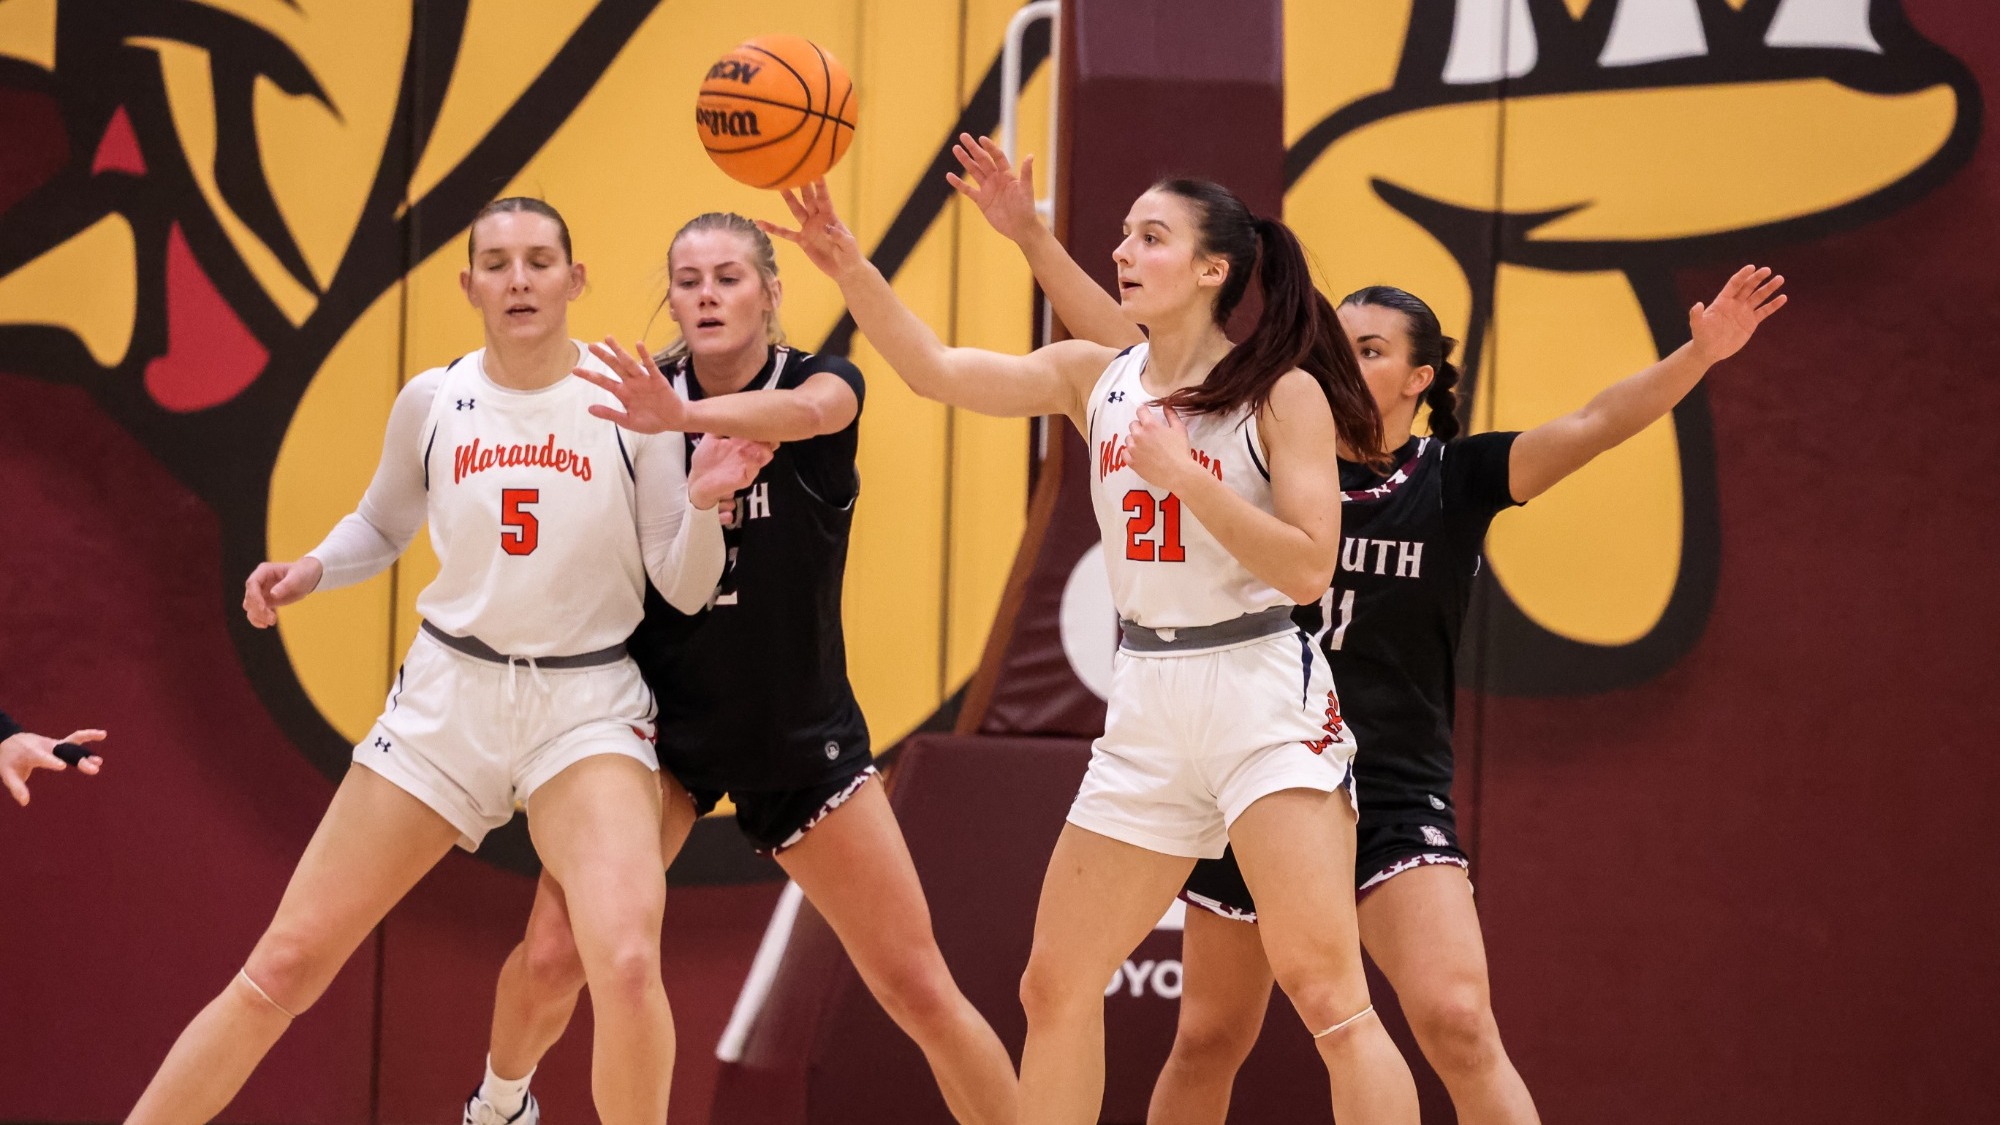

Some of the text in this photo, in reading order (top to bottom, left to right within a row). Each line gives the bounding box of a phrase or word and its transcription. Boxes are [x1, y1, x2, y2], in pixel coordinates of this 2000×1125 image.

[696, 109, 762, 137] Wilso
[454, 433, 592, 485] Marauders
[500, 488, 539, 556] 5
[1122, 489, 1186, 562] 21
[1341, 536, 1424, 578] UTH
